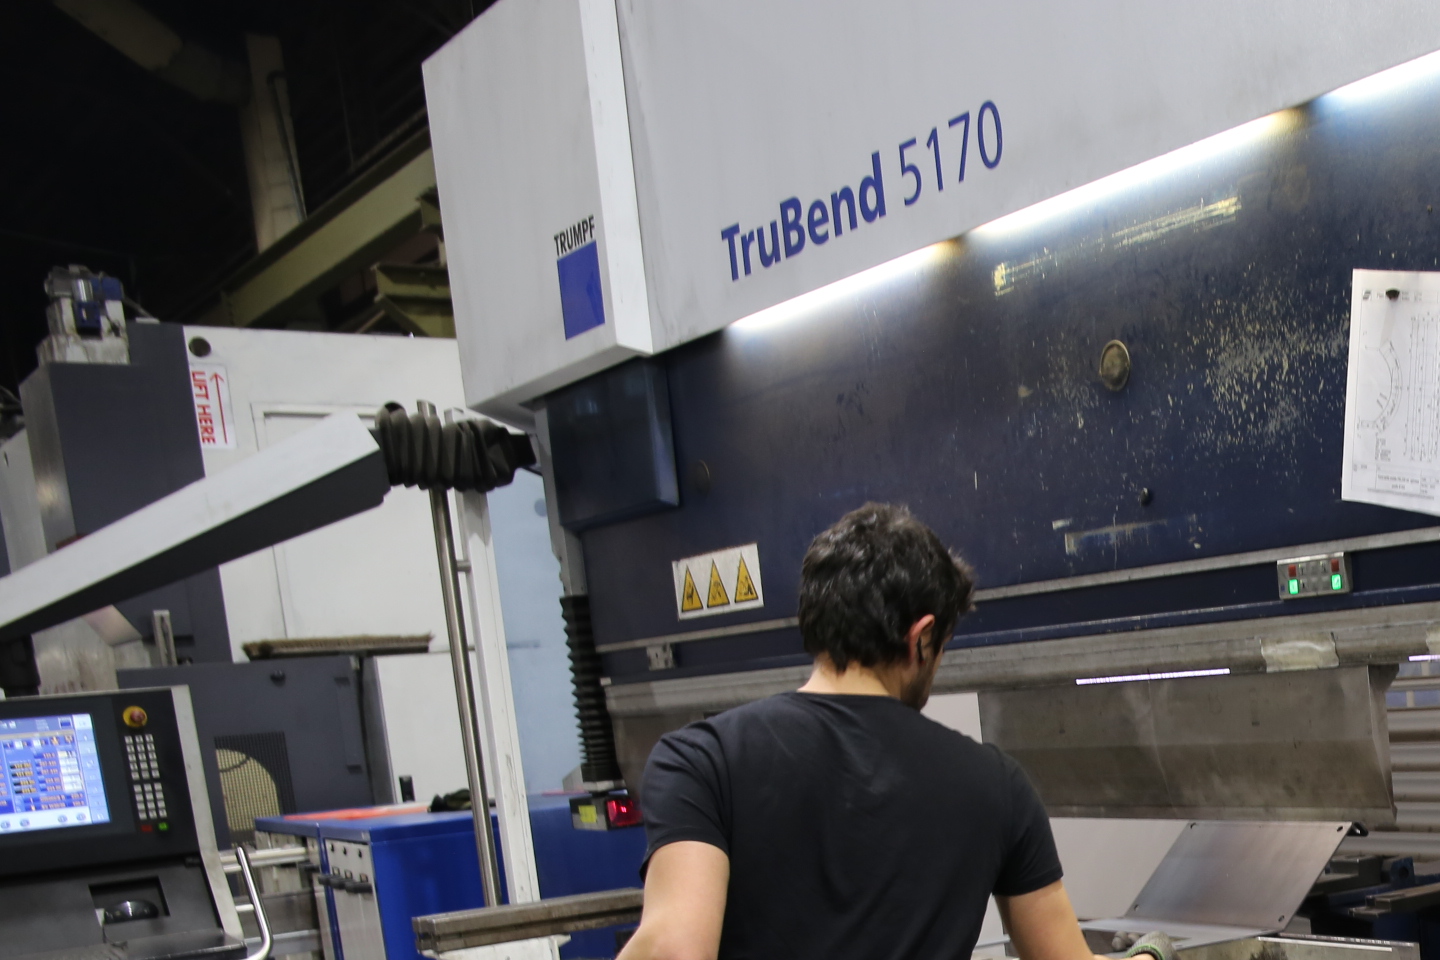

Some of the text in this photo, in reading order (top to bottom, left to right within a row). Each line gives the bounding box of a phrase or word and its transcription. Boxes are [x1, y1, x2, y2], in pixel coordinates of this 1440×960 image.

[720, 99, 1004, 282] TruBend 5170
[553, 213, 595, 257] TRUMPF
[192, 370, 216, 445] LIFT HERE
